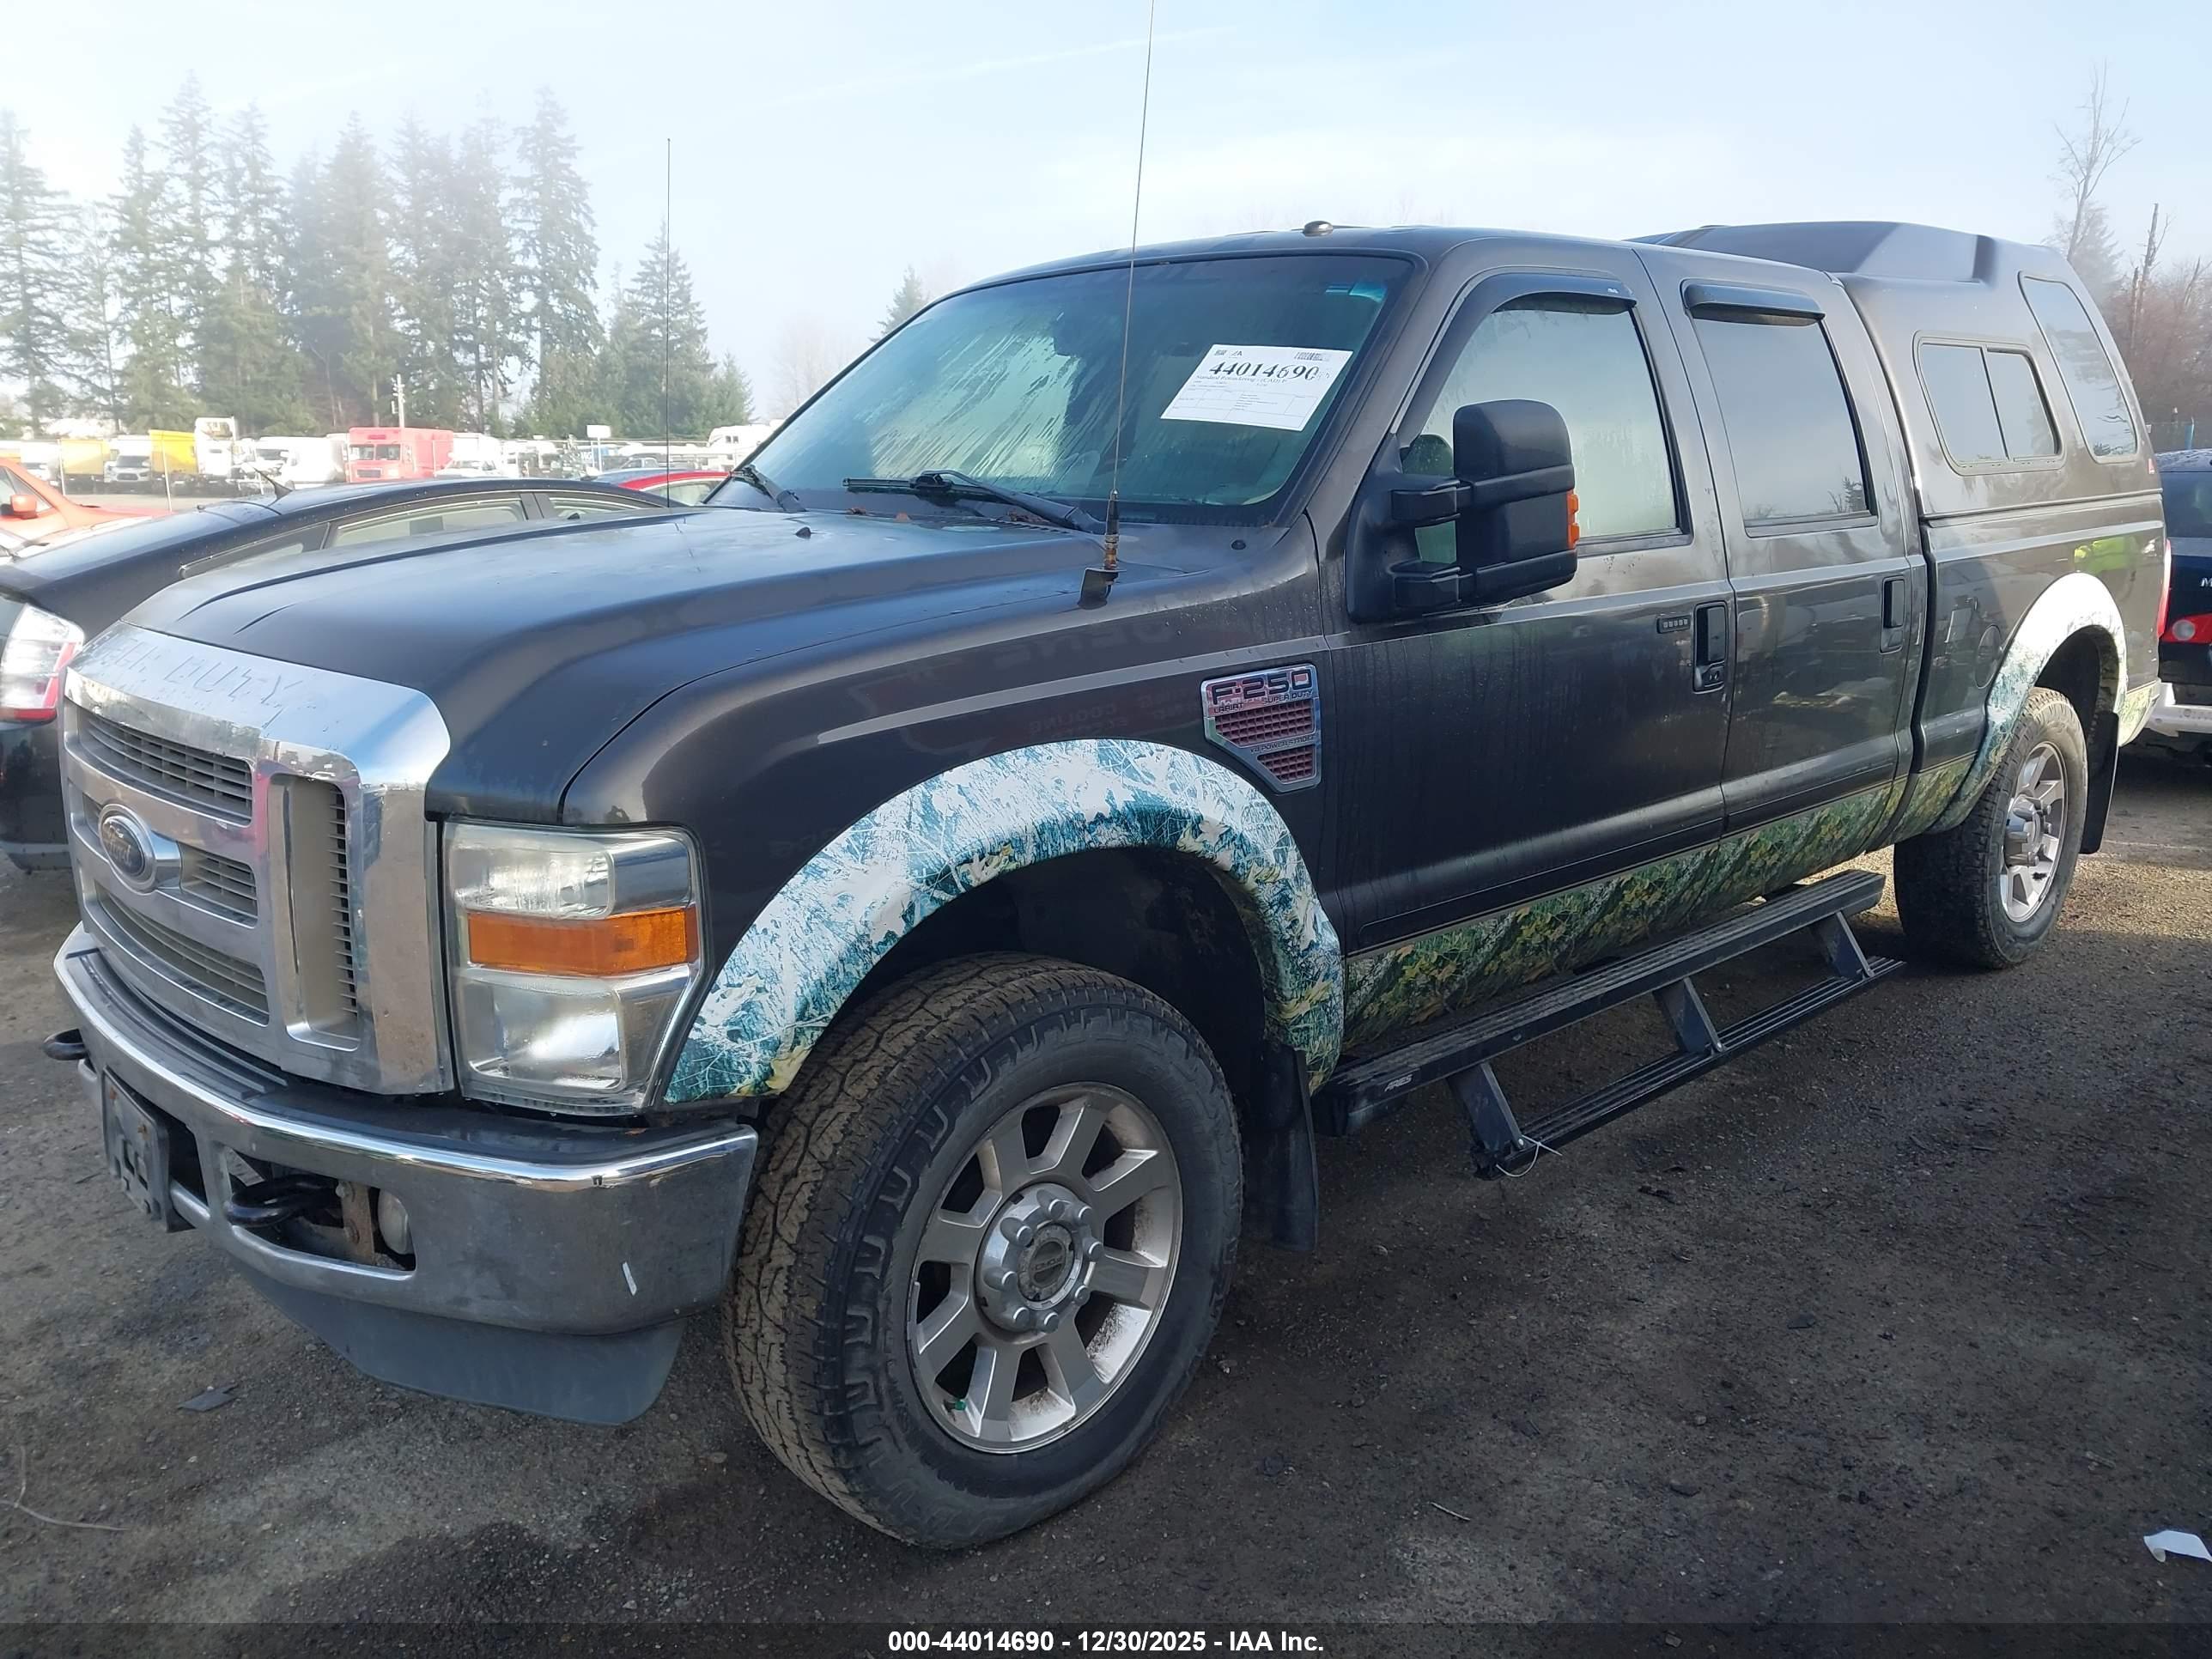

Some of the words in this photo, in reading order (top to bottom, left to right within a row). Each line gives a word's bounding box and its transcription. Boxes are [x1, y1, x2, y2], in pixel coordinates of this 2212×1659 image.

[1209, 361, 1320, 381] 44014690
[1212, 669, 1313, 705] F-250
[1262, 694, 1290, 705] SUPER
[1291, 690, 1314, 700] DUTY
[1214, 702, 1244, 714] LARIAT
